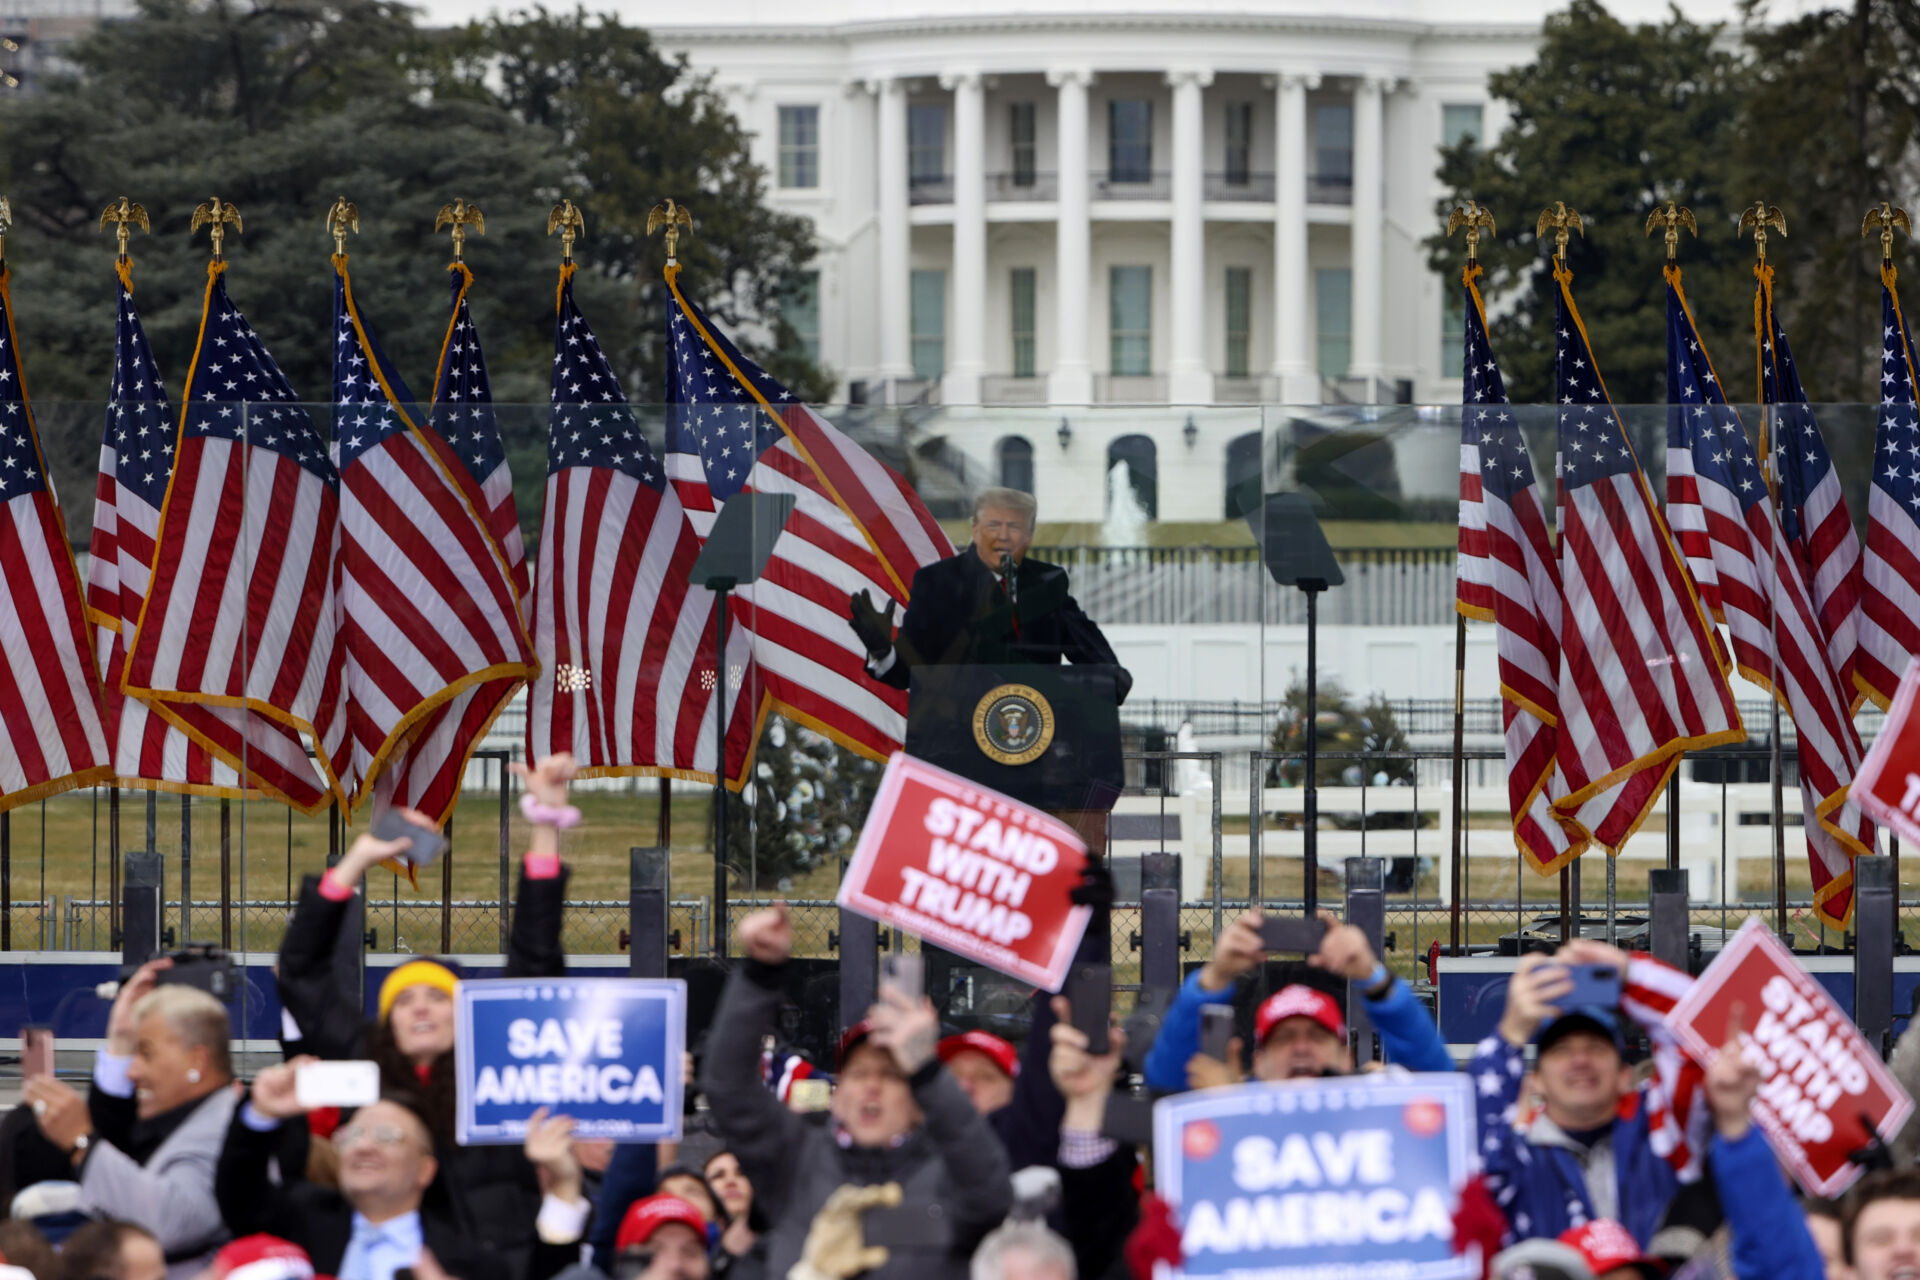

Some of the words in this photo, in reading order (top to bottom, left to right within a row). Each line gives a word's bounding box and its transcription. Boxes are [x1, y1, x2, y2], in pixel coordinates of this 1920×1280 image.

[924, 797, 1059, 875] STAND
[900, 866, 1032, 945] TRUMP
[928, 838, 1032, 908] WITH
[507, 1018, 623, 1059] SAVE
[1753, 1010, 1843, 1110] WITH
[1760, 975, 1869, 1095] STAND
[475, 1064, 664, 1105] AMERICA
[1233, 1129, 1394, 1191] SAVE
[1181, 1186, 1453, 1255] AMERICA
